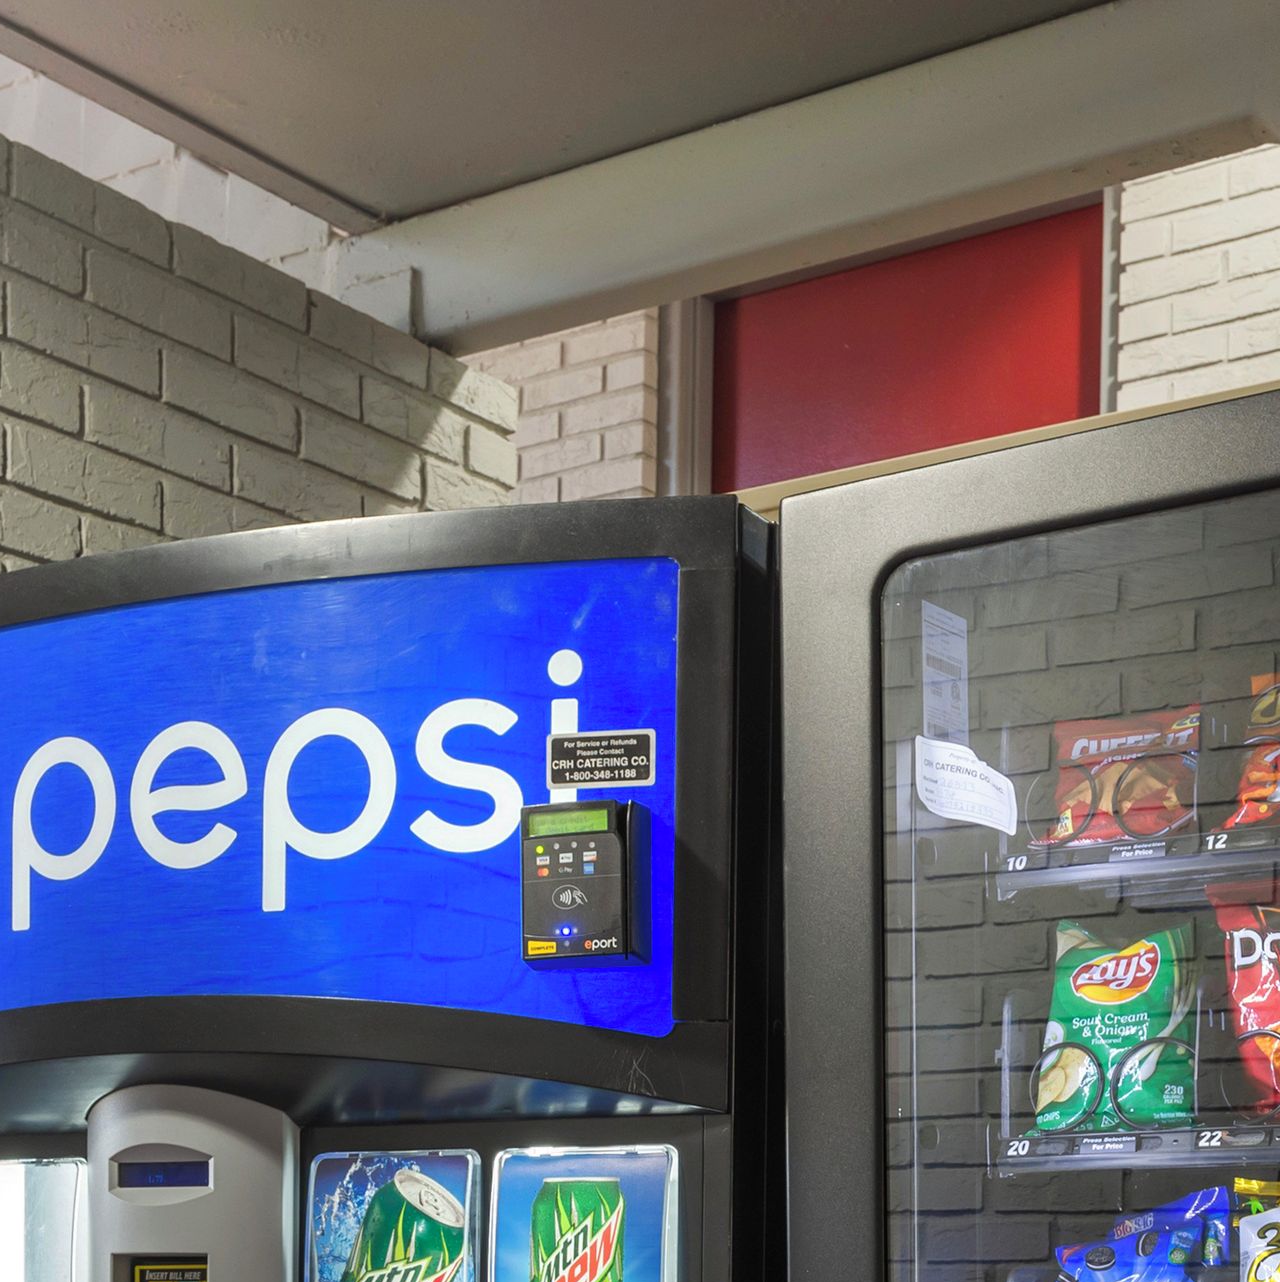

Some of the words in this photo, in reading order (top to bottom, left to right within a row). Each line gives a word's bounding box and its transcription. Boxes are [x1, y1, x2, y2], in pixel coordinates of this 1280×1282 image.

[577, 740, 600, 748] Service
[610, 738, 637, 747] Refunds
[552, 760, 574, 770] CRH
[576, 757, 630, 769] CATERING
[631, 756, 649, 766] CO.
[935, 762, 978, 778] CATERING
[564, 769, 637, 781] 1-800-348-1188
[12, 649, 584, 932] pepsi
[1206, 834, 1228, 850] 12
[1006, 856, 1028, 871] 10
[584, 937, 618, 951] eport
[1075, 948, 1156, 990] Lay's
[1072, 1013, 1100, 1030] Sour
[1104, 1011, 1149, 1025] Cream
[1164, 1084, 1184, 1094] 230
[1198, 1131, 1222, 1147] 22
[1007, 1140, 1030, 1156] 20
[145, 1270, 169, 1281] INSERT
[169, 1271, 183, 1281] BILL
[184, 1271, 201, 1281] HERE
